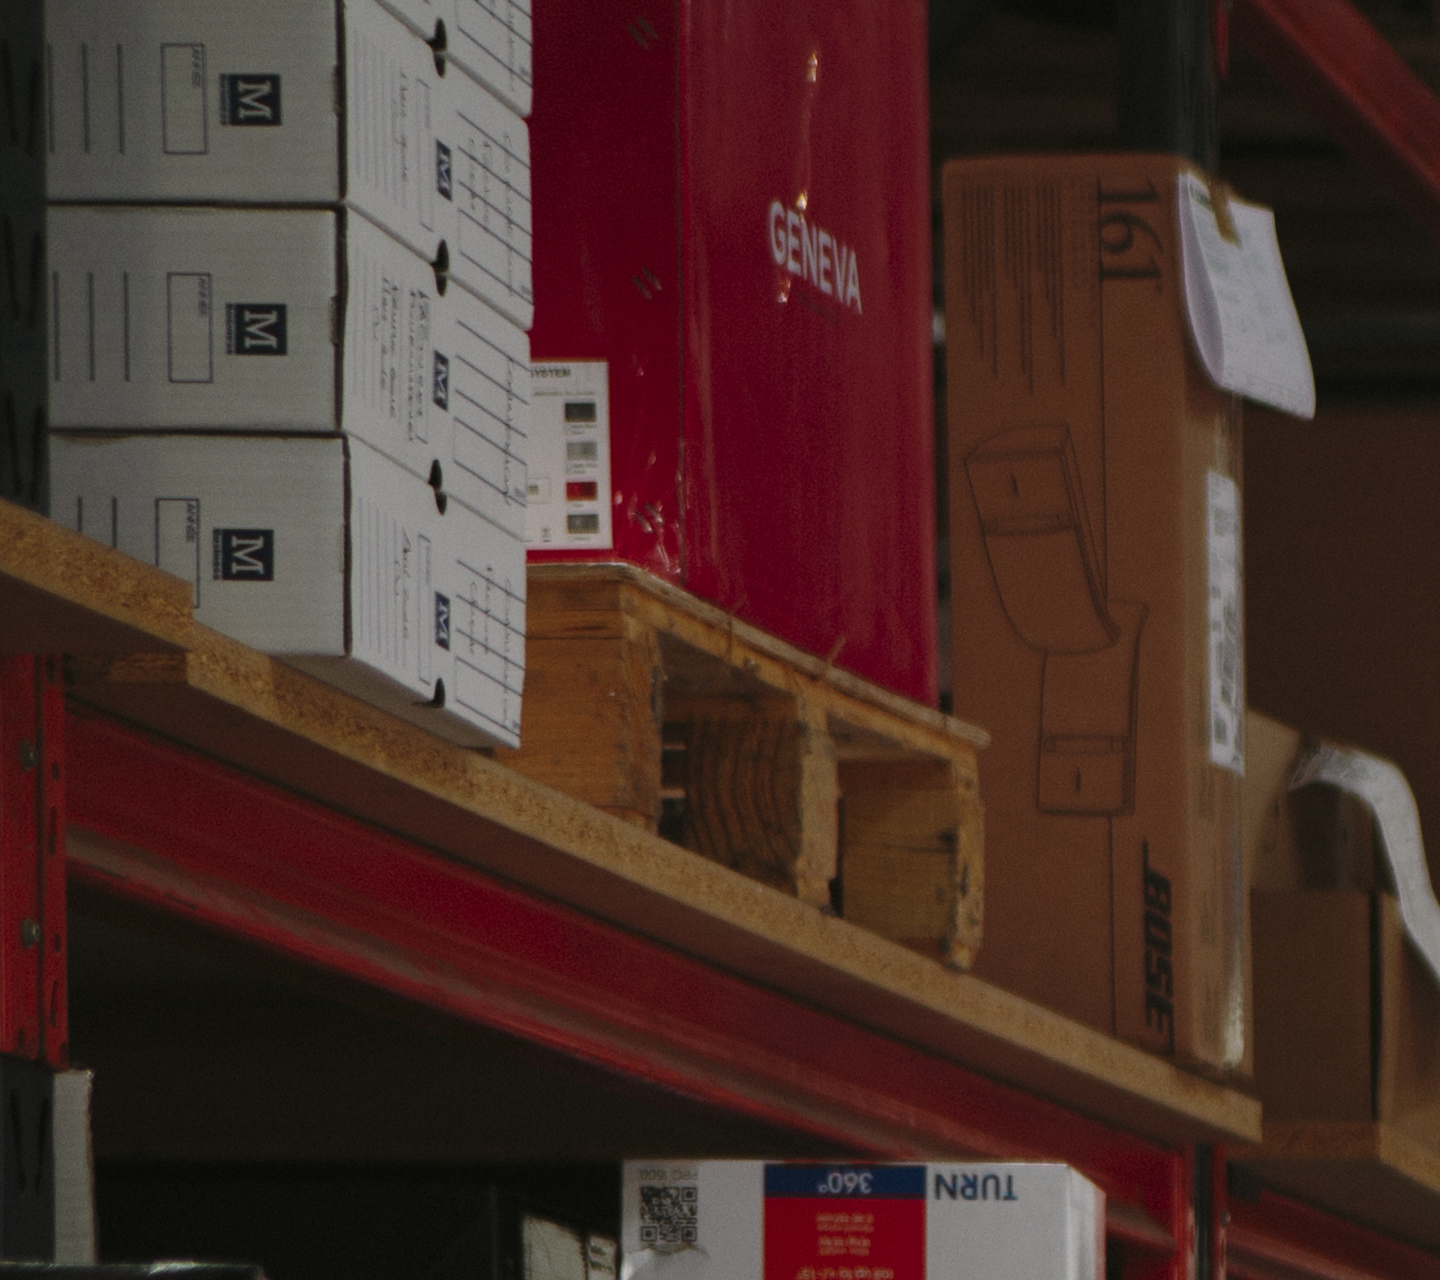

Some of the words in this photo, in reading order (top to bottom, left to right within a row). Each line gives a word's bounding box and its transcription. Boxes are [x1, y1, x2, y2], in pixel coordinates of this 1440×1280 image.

[769, 200, 863, 314] GENEVA
[1142, 839, 1176, 1057] BOSE
[818, 1171, 874, 1194] 360°
[934, 1173, 1017, 1201] TURN
